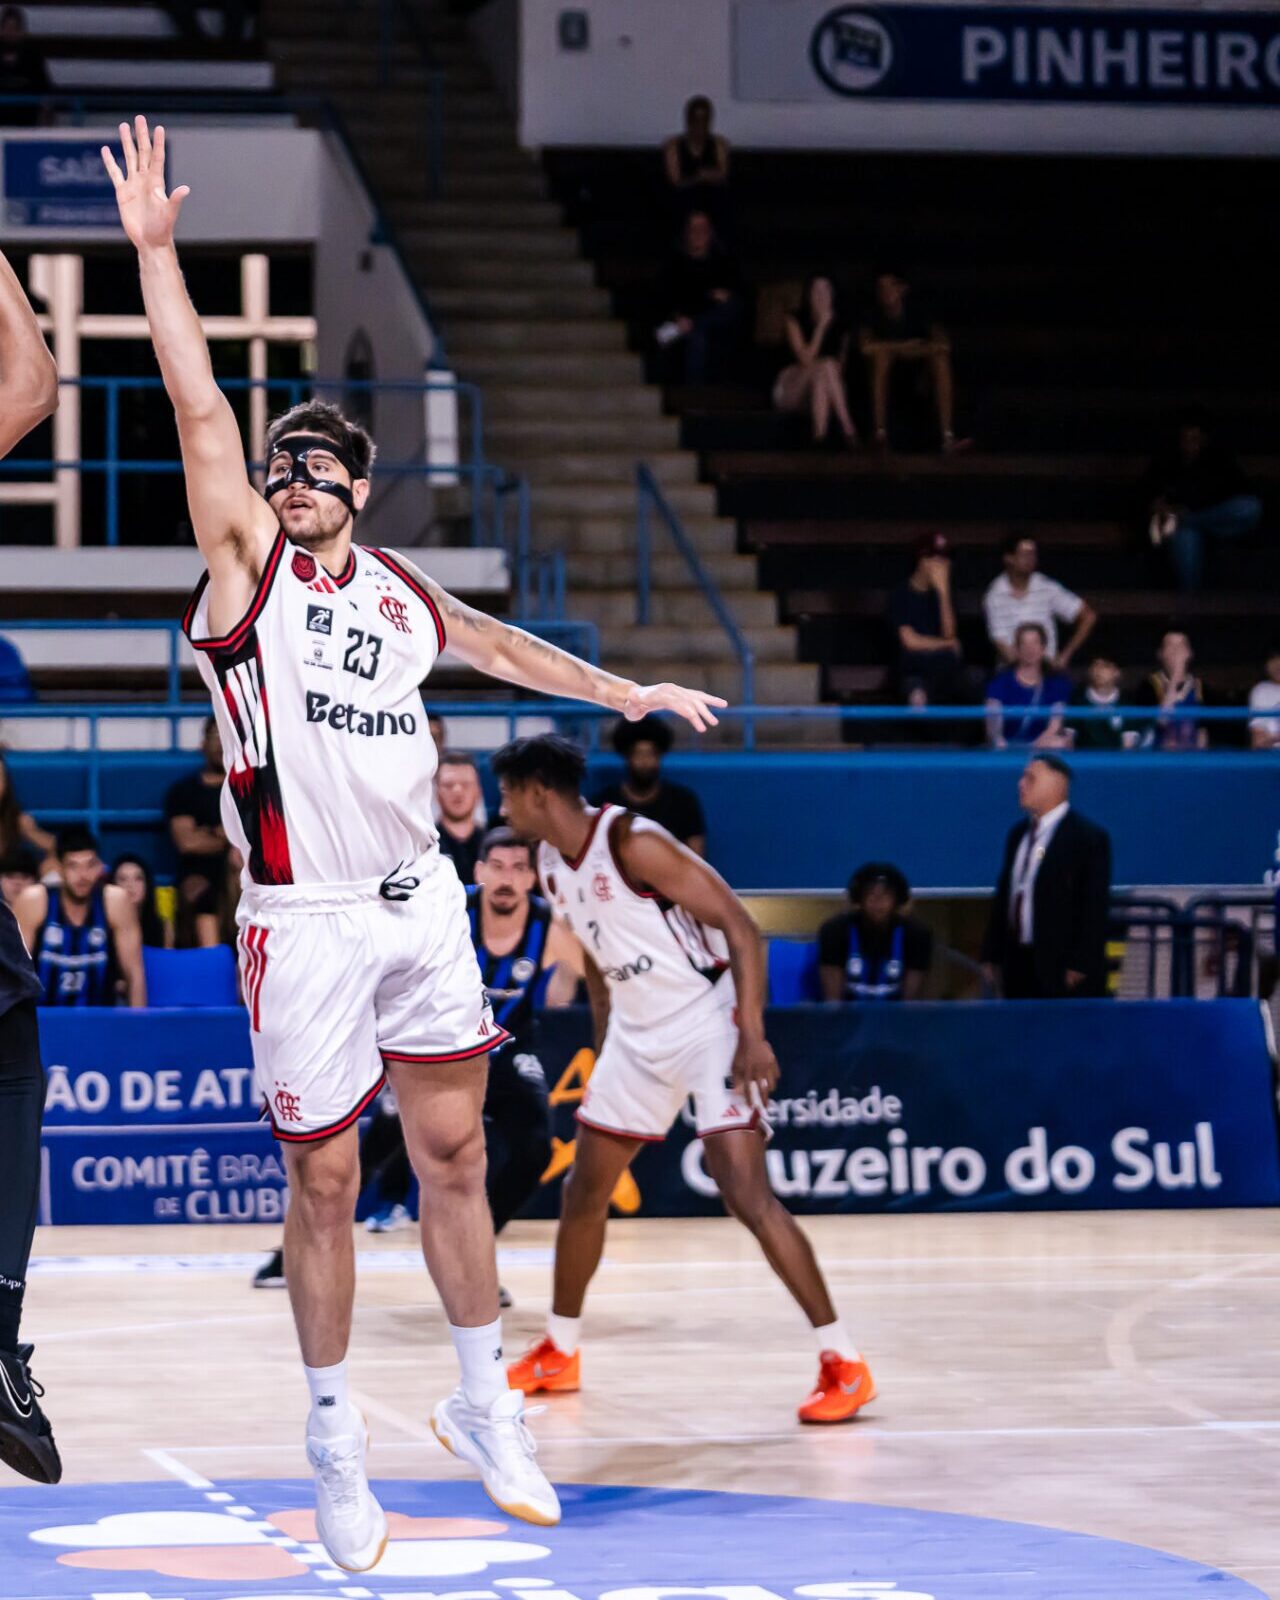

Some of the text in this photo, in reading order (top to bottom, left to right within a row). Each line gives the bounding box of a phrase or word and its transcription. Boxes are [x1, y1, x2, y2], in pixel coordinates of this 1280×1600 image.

[962, 26, 1280, 87] PINHEIR
[343, 627, 383, 681] 23
[306, 690, 416, 736] Betano
[120, 1069, 183, 1112] DE
[71, 1147, 288, 1191] COMITÊ BRA
[681, 1120, 1222, 1198] Cuzeiro do Sul
[155, 1196, 181, 1217] DE
